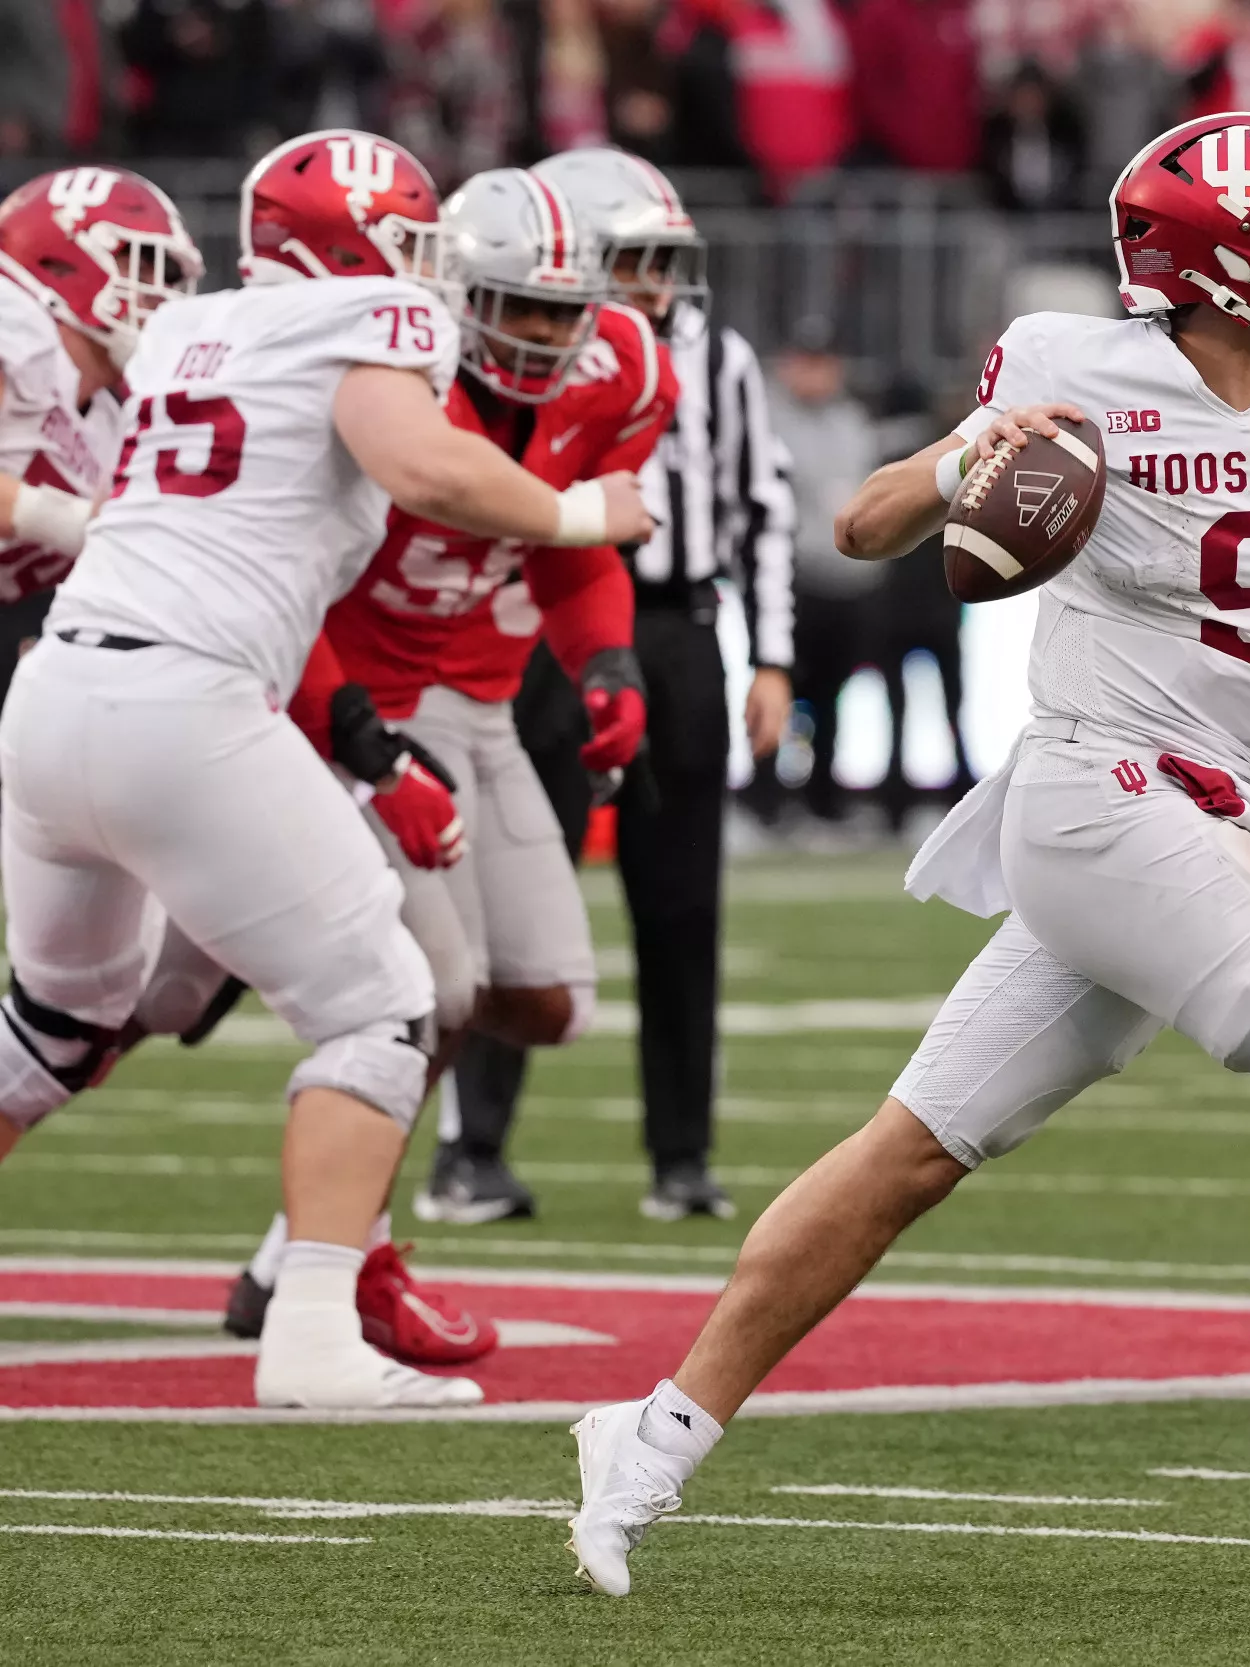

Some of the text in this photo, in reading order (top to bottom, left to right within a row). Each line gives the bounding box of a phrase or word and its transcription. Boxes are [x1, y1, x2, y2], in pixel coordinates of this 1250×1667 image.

[372, 305, 435, 352] 75
[978, 345, 1004, 407] 9
[1046, 493, 1079, 540] DIME
[1111, 759, 1148, 797] IU
